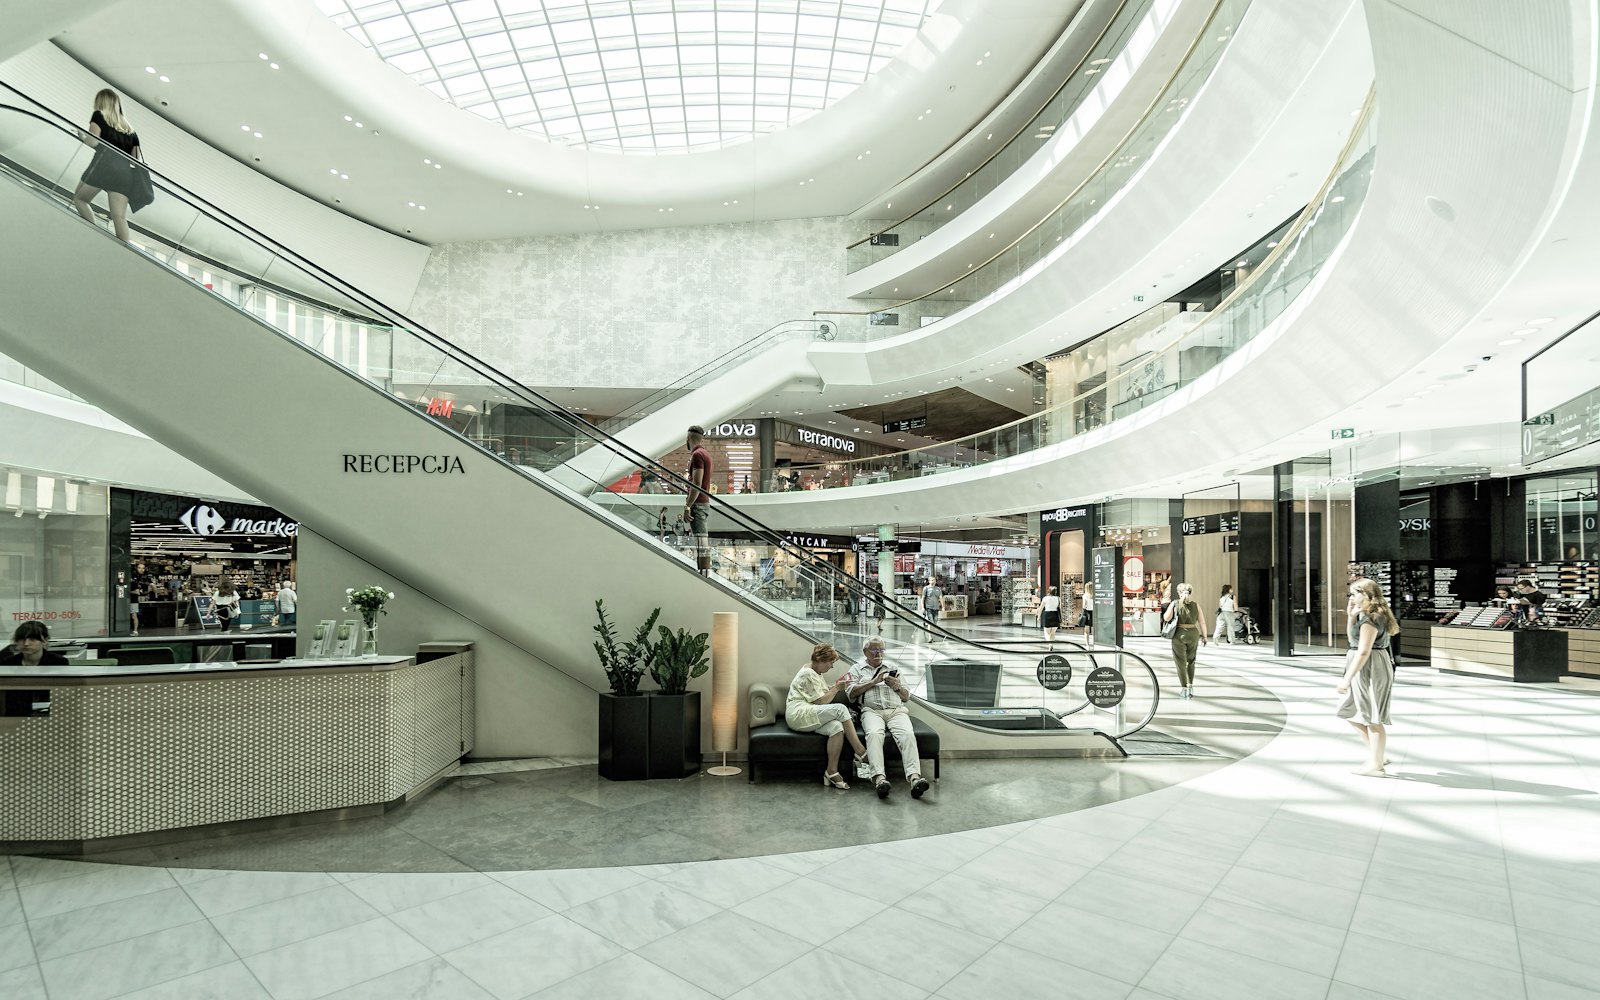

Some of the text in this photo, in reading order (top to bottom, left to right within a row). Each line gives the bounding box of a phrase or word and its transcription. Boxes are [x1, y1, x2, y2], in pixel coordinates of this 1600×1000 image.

[425, 397, 453, 419] H&M
[797, 428, 855, 453] Terranova
[1523, 428, 1532, 455] 0
[342, 454, 465, 474] RECEPCJA
[1182, 520, 1189, 533] 0
[968, 544, 986, 555] Media
[1126, 570, 1141, 578] SALE
[12, 612, 43, 621] TERAZ
[43, 611, 57, 620] DO
